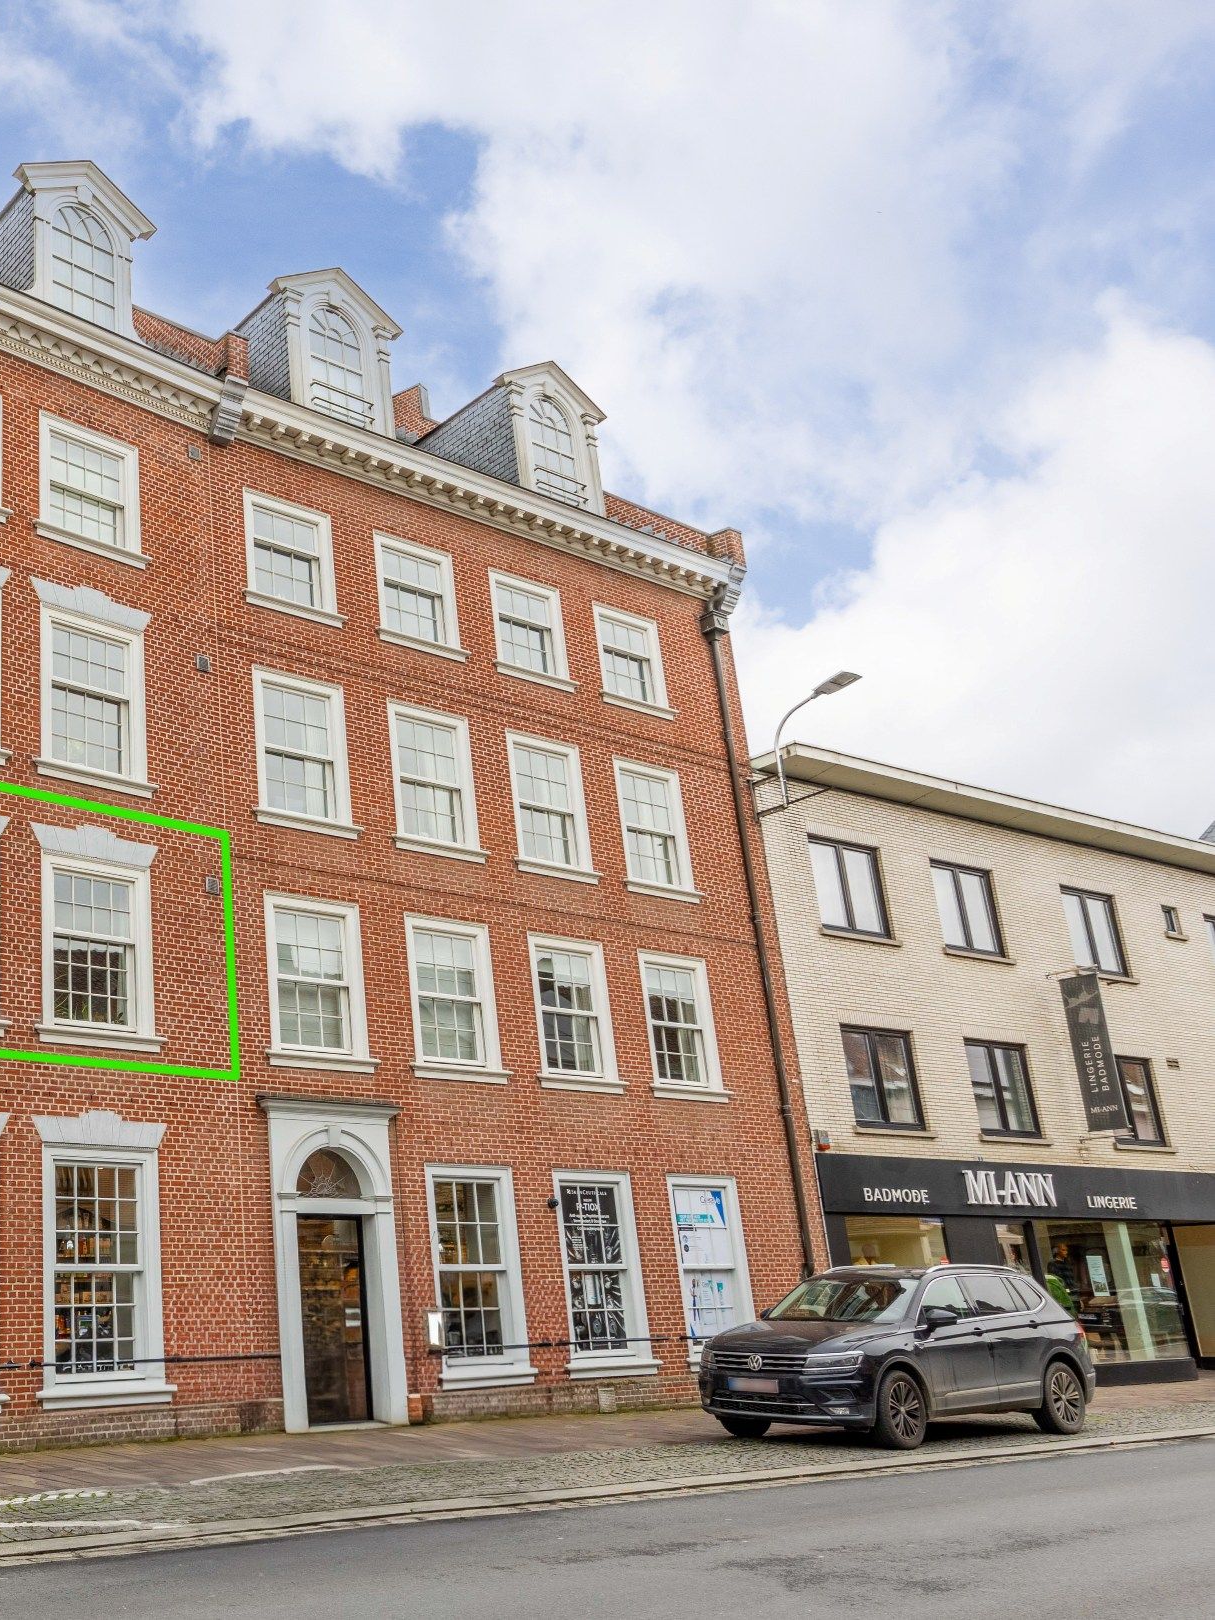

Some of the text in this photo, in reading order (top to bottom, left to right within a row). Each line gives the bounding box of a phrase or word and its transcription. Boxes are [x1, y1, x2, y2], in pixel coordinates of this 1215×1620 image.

[1082, 1041, 1099, 1093] LINGERIE
[1092, 1036, 1110, 1091] BADMODE
[1090, 1104, 1119, 1114] MI-ANN
[863, 1187, 930, 1204] BADMODE
[962, 1169, 1058, 1208] MI-ANN
[1087, 1195, 1138, 1210] LINGERIE
